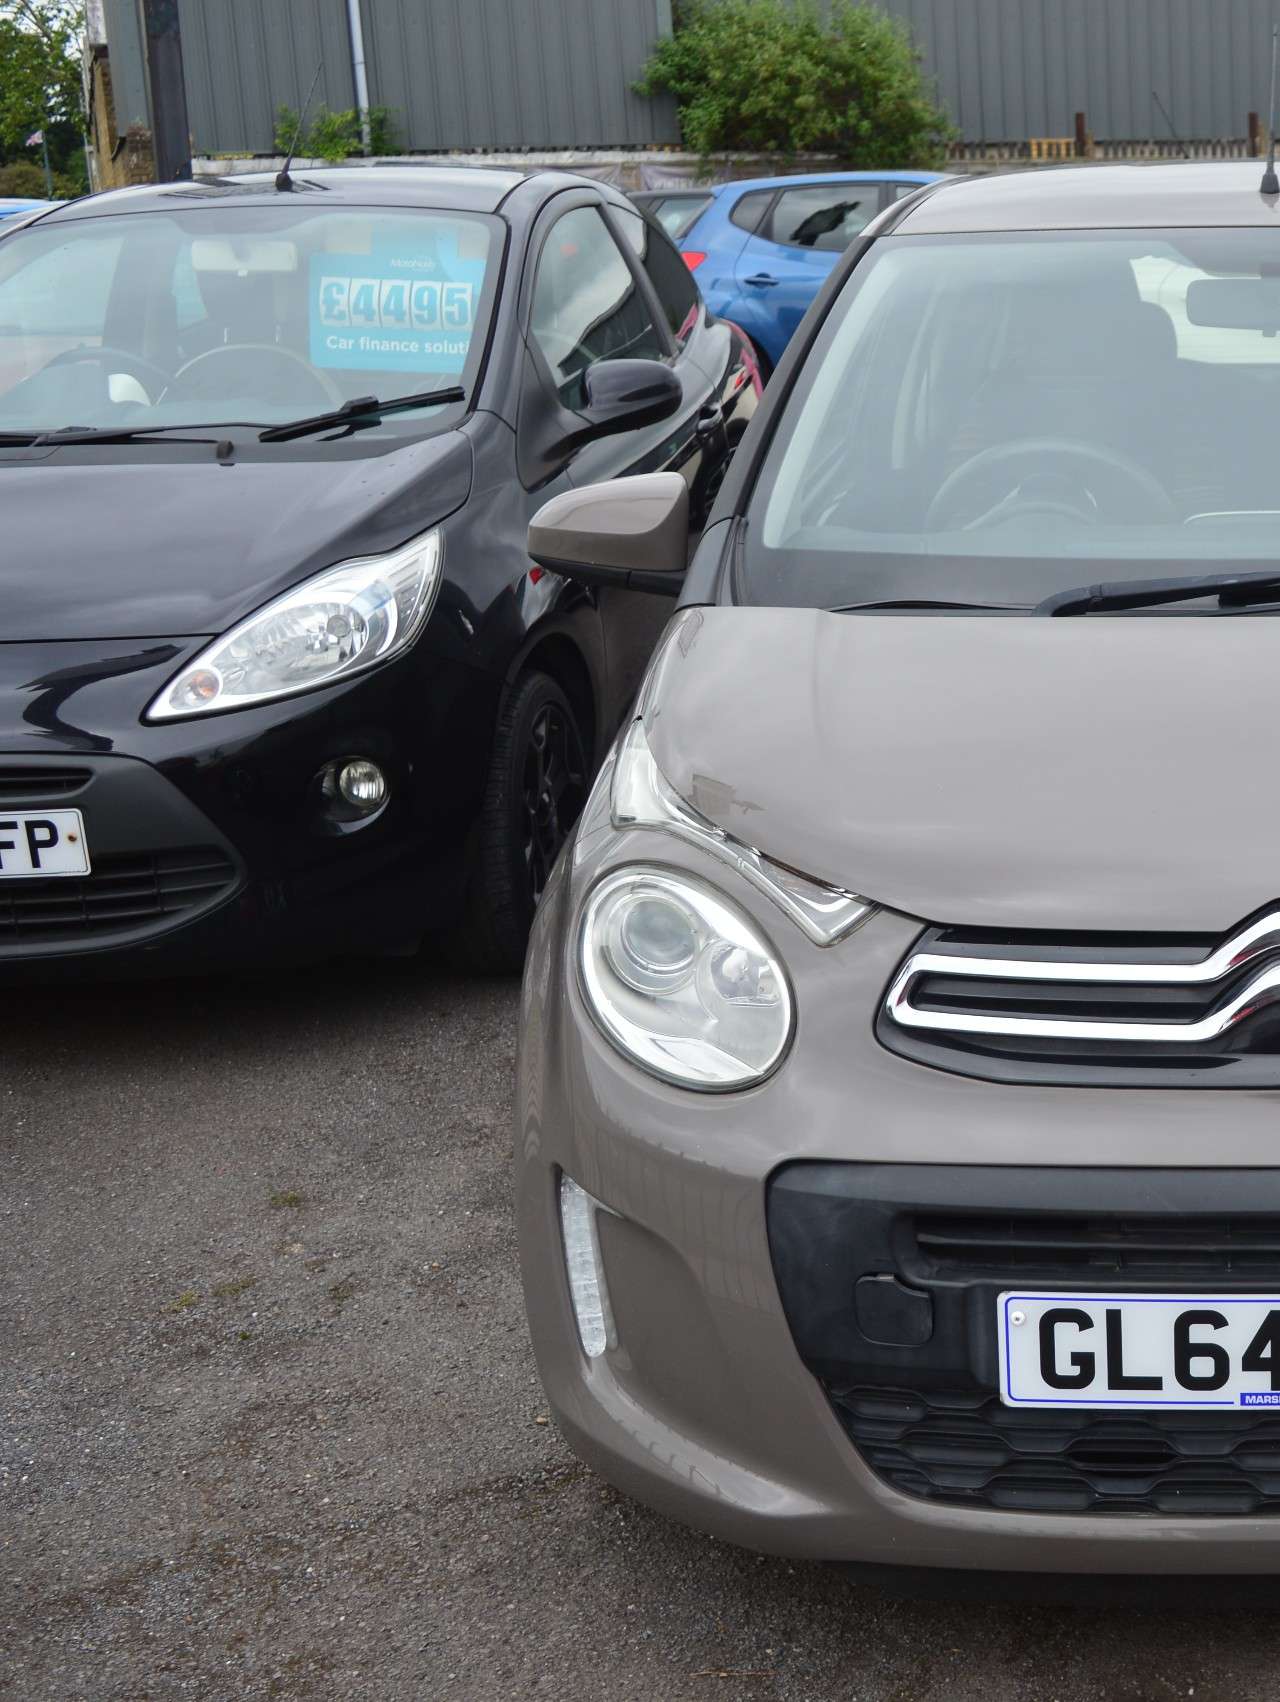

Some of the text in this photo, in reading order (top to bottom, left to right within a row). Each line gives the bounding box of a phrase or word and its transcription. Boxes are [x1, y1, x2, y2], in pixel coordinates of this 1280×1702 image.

[321, 282, 471, 326] £4495
[326, 335, 354, 350] Car
[359, 336, 419, 353] finance
